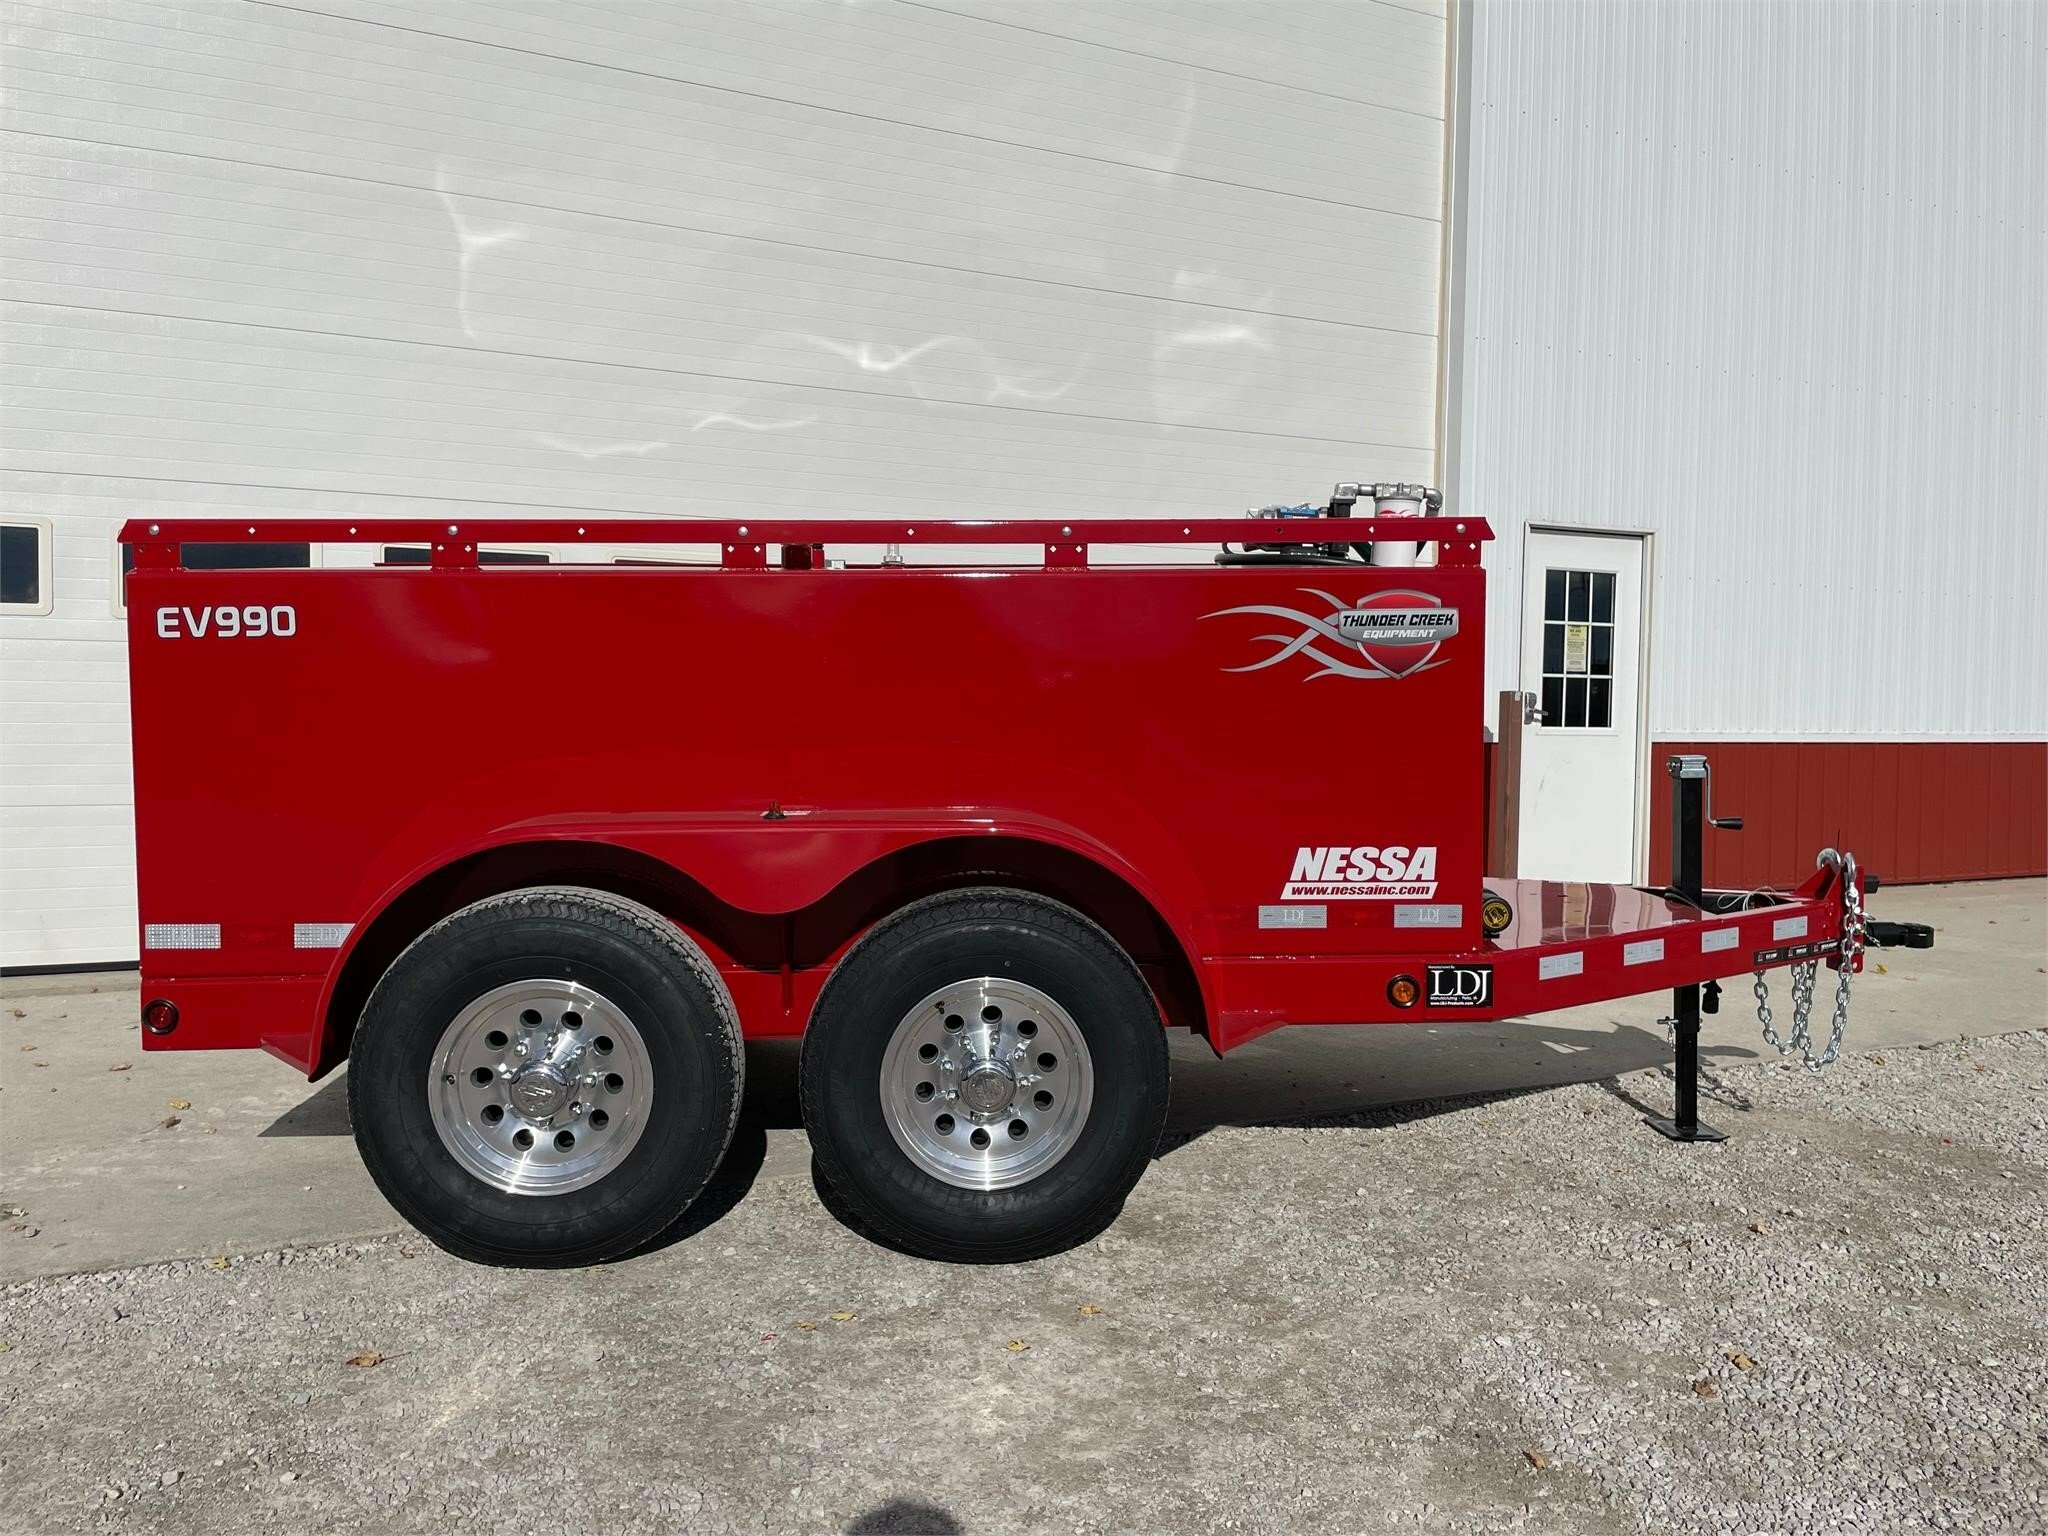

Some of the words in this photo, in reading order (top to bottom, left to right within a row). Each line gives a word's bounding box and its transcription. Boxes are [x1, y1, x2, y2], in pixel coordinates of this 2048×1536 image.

[156, 605, 297, 638] EV990
[1343, 614, 1406, 627] THUNDER
[1408, 613, 1455, 626] CREEK
[1362, 628, 1437, 639] EQUIPMENT
[1289, 846, 1437, 882] NESSA
[1291, 884, 1431, 896] www.nessainc.com
[1284, 909, 1305, 924] LDJ
[1418, 908, 1440, 923] LDJ
[1430, 970, 1492, 1004] LDJ
